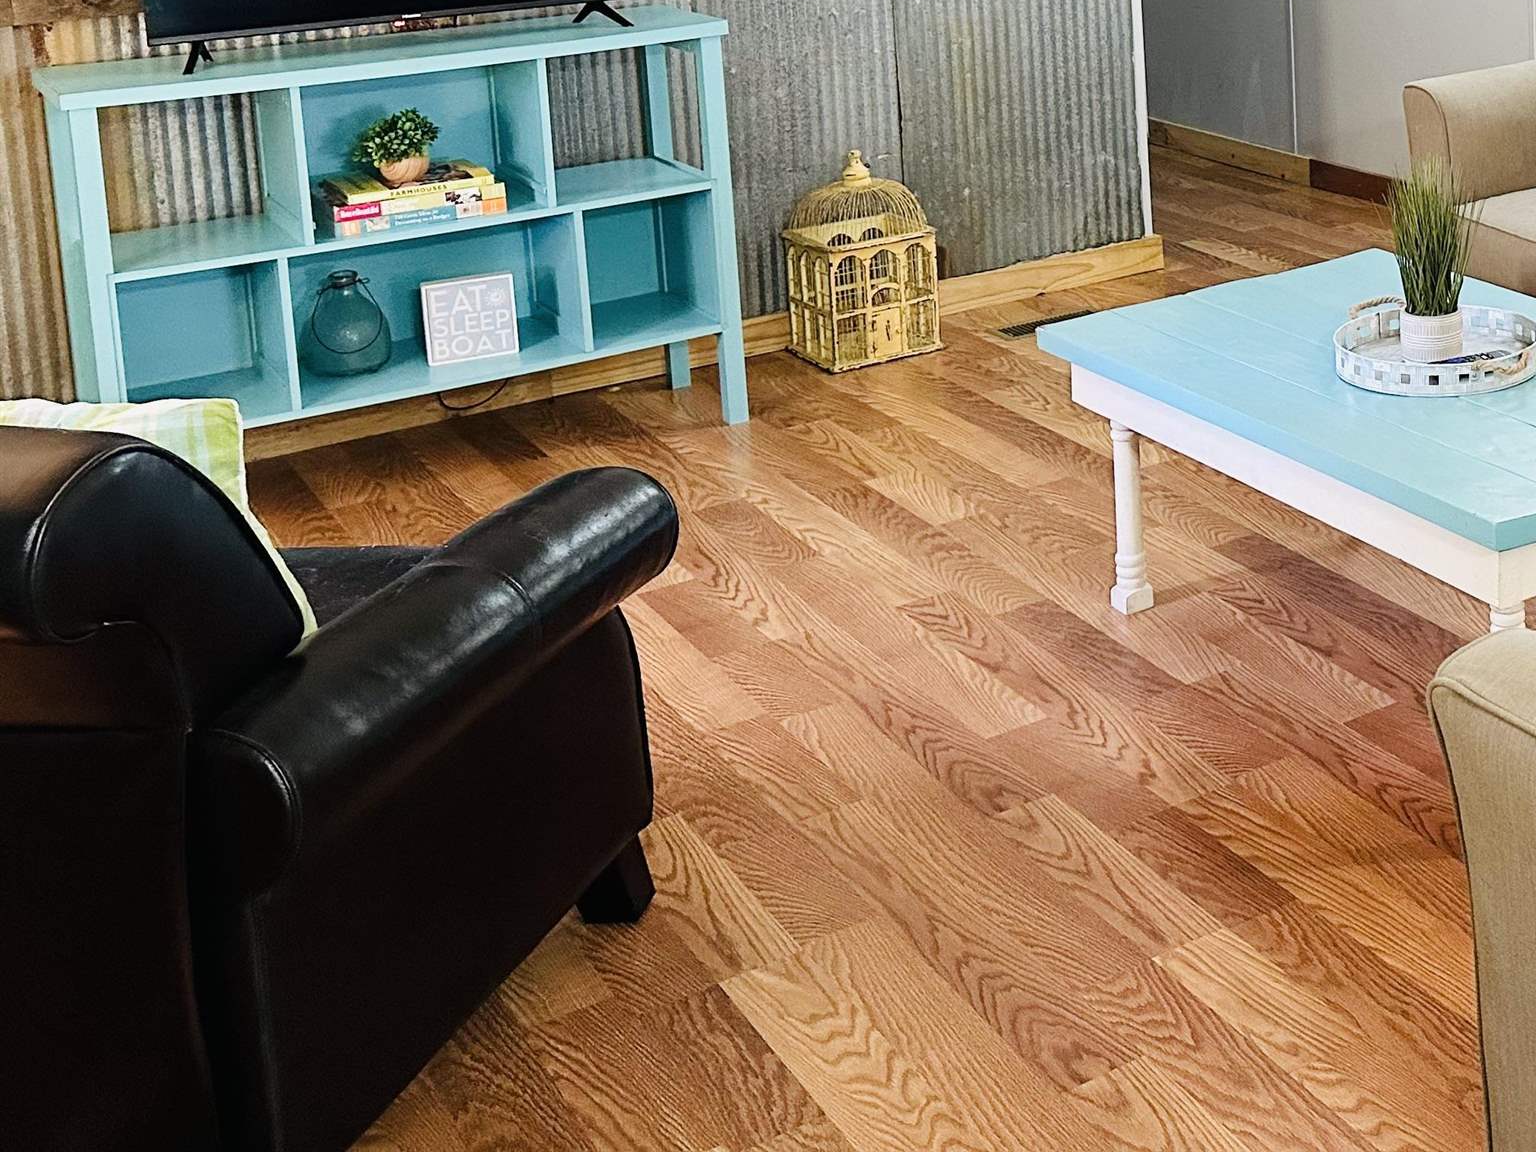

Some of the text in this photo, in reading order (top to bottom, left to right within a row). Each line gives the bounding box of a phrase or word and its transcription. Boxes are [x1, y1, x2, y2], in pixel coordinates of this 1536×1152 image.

[390, 184, 448, 197] FARMHOUSES
[430, 284, 487, 318] EAT
[433, 309, 510, 337] SLEEP
[434, 329, 511, 360] BOAT
